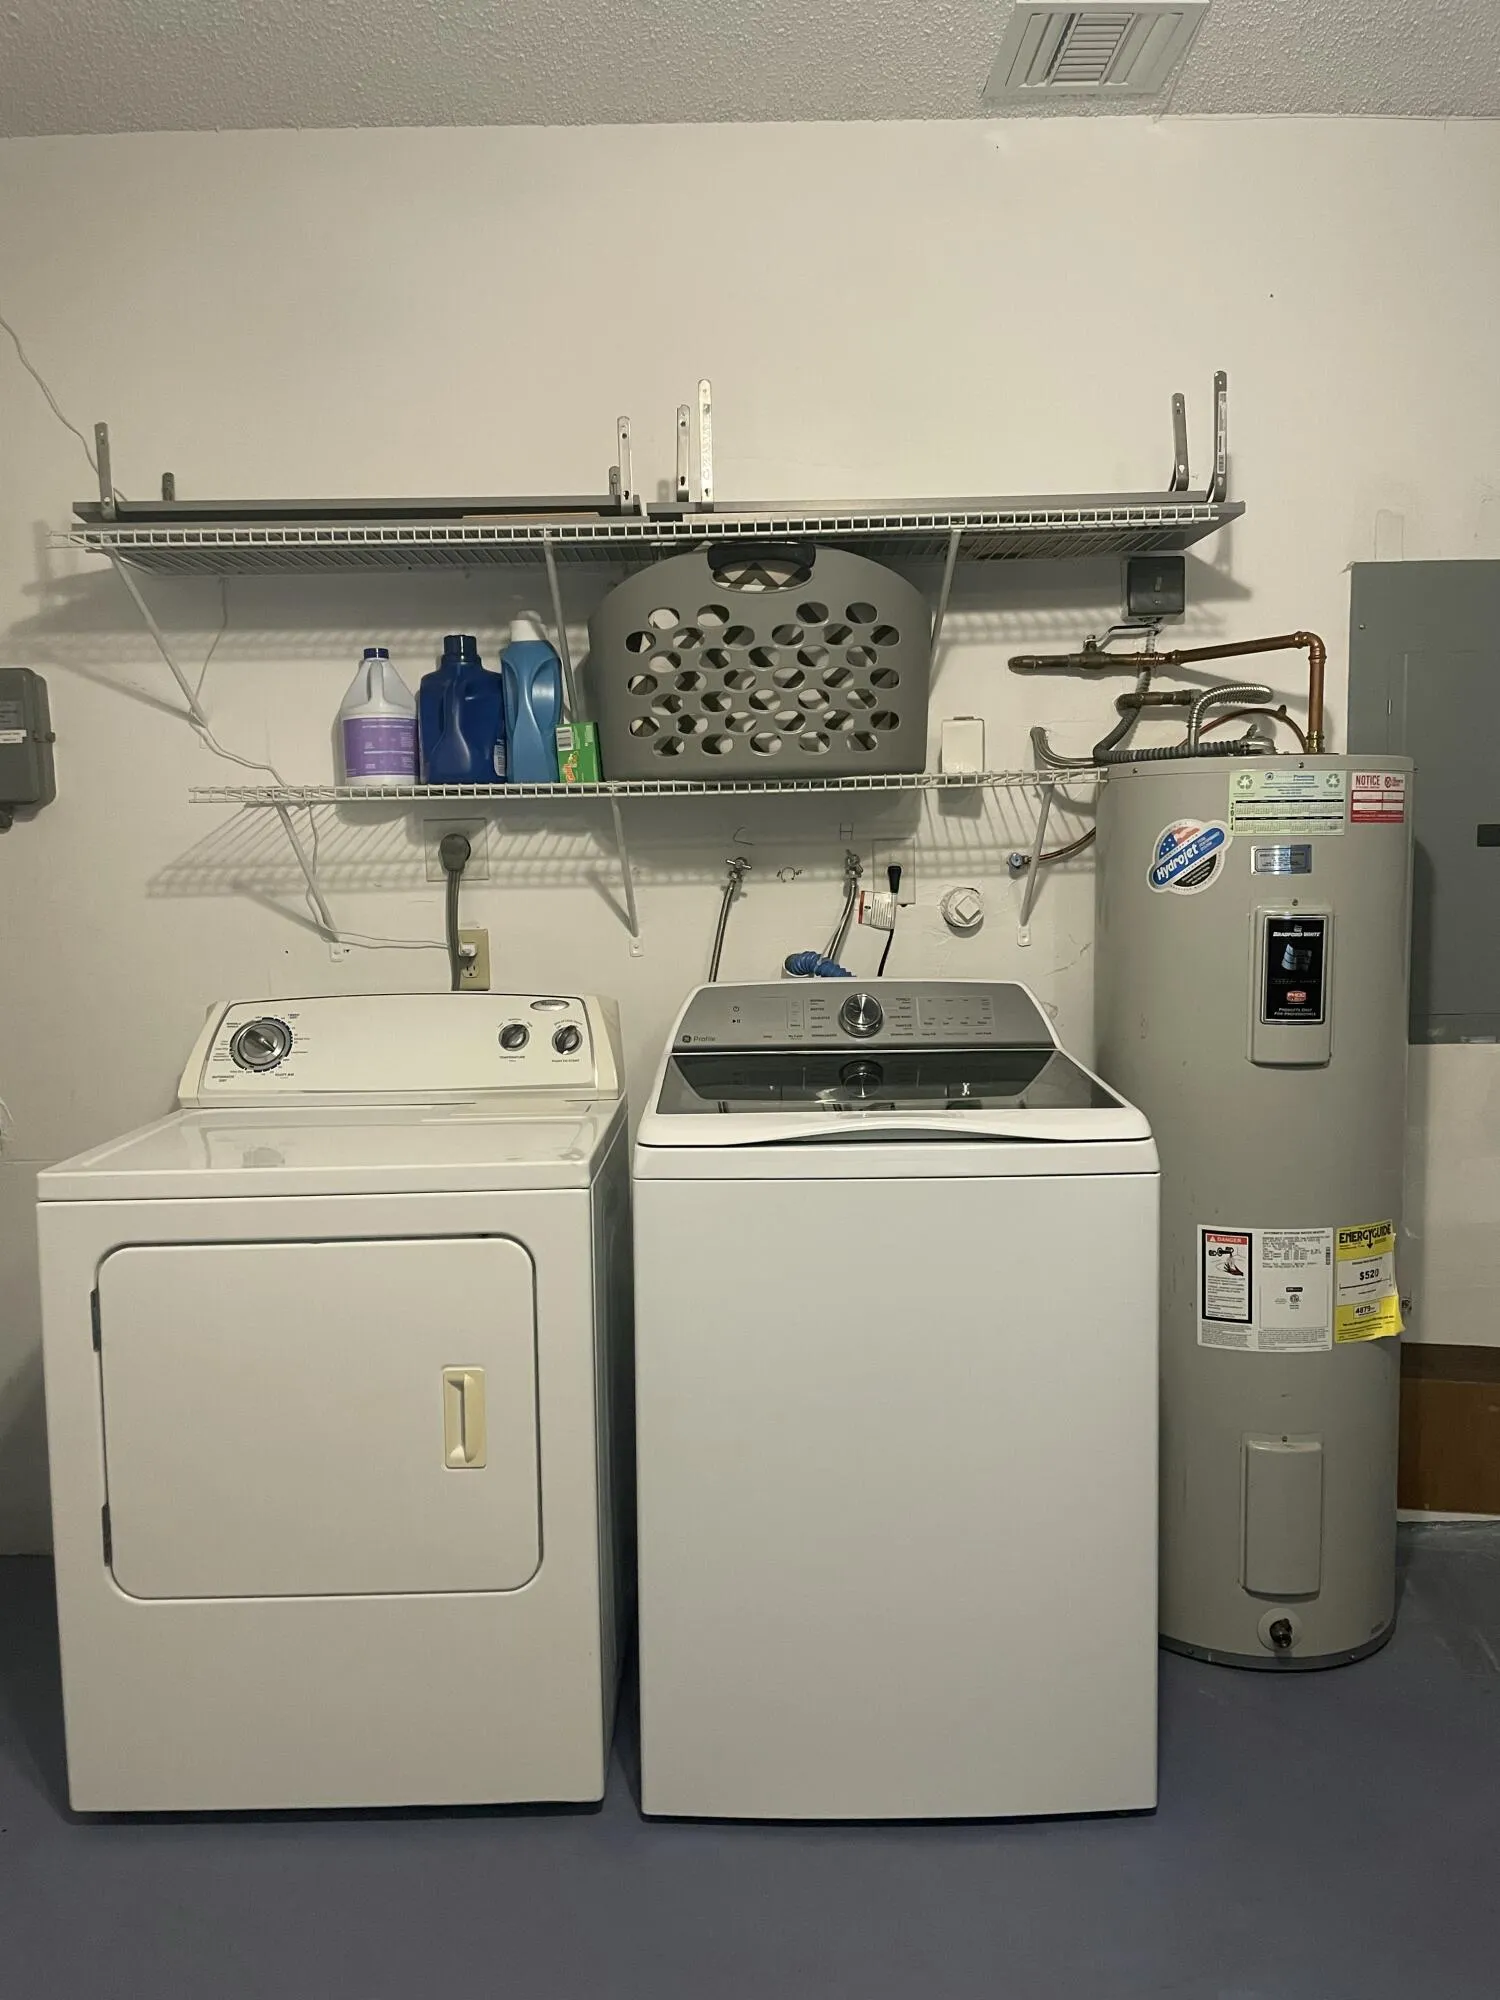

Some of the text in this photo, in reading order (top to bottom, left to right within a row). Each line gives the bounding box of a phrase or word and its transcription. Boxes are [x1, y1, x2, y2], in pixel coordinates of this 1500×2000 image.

[1356, 775, 1380, 786] NOTICE
[839, 822, 854, 841] H
[1156, 843, 1199, 881] Hydrojet
[693, 1035, 716, 1043] Profile
[1360, 1269, 1379, 1281] $520
